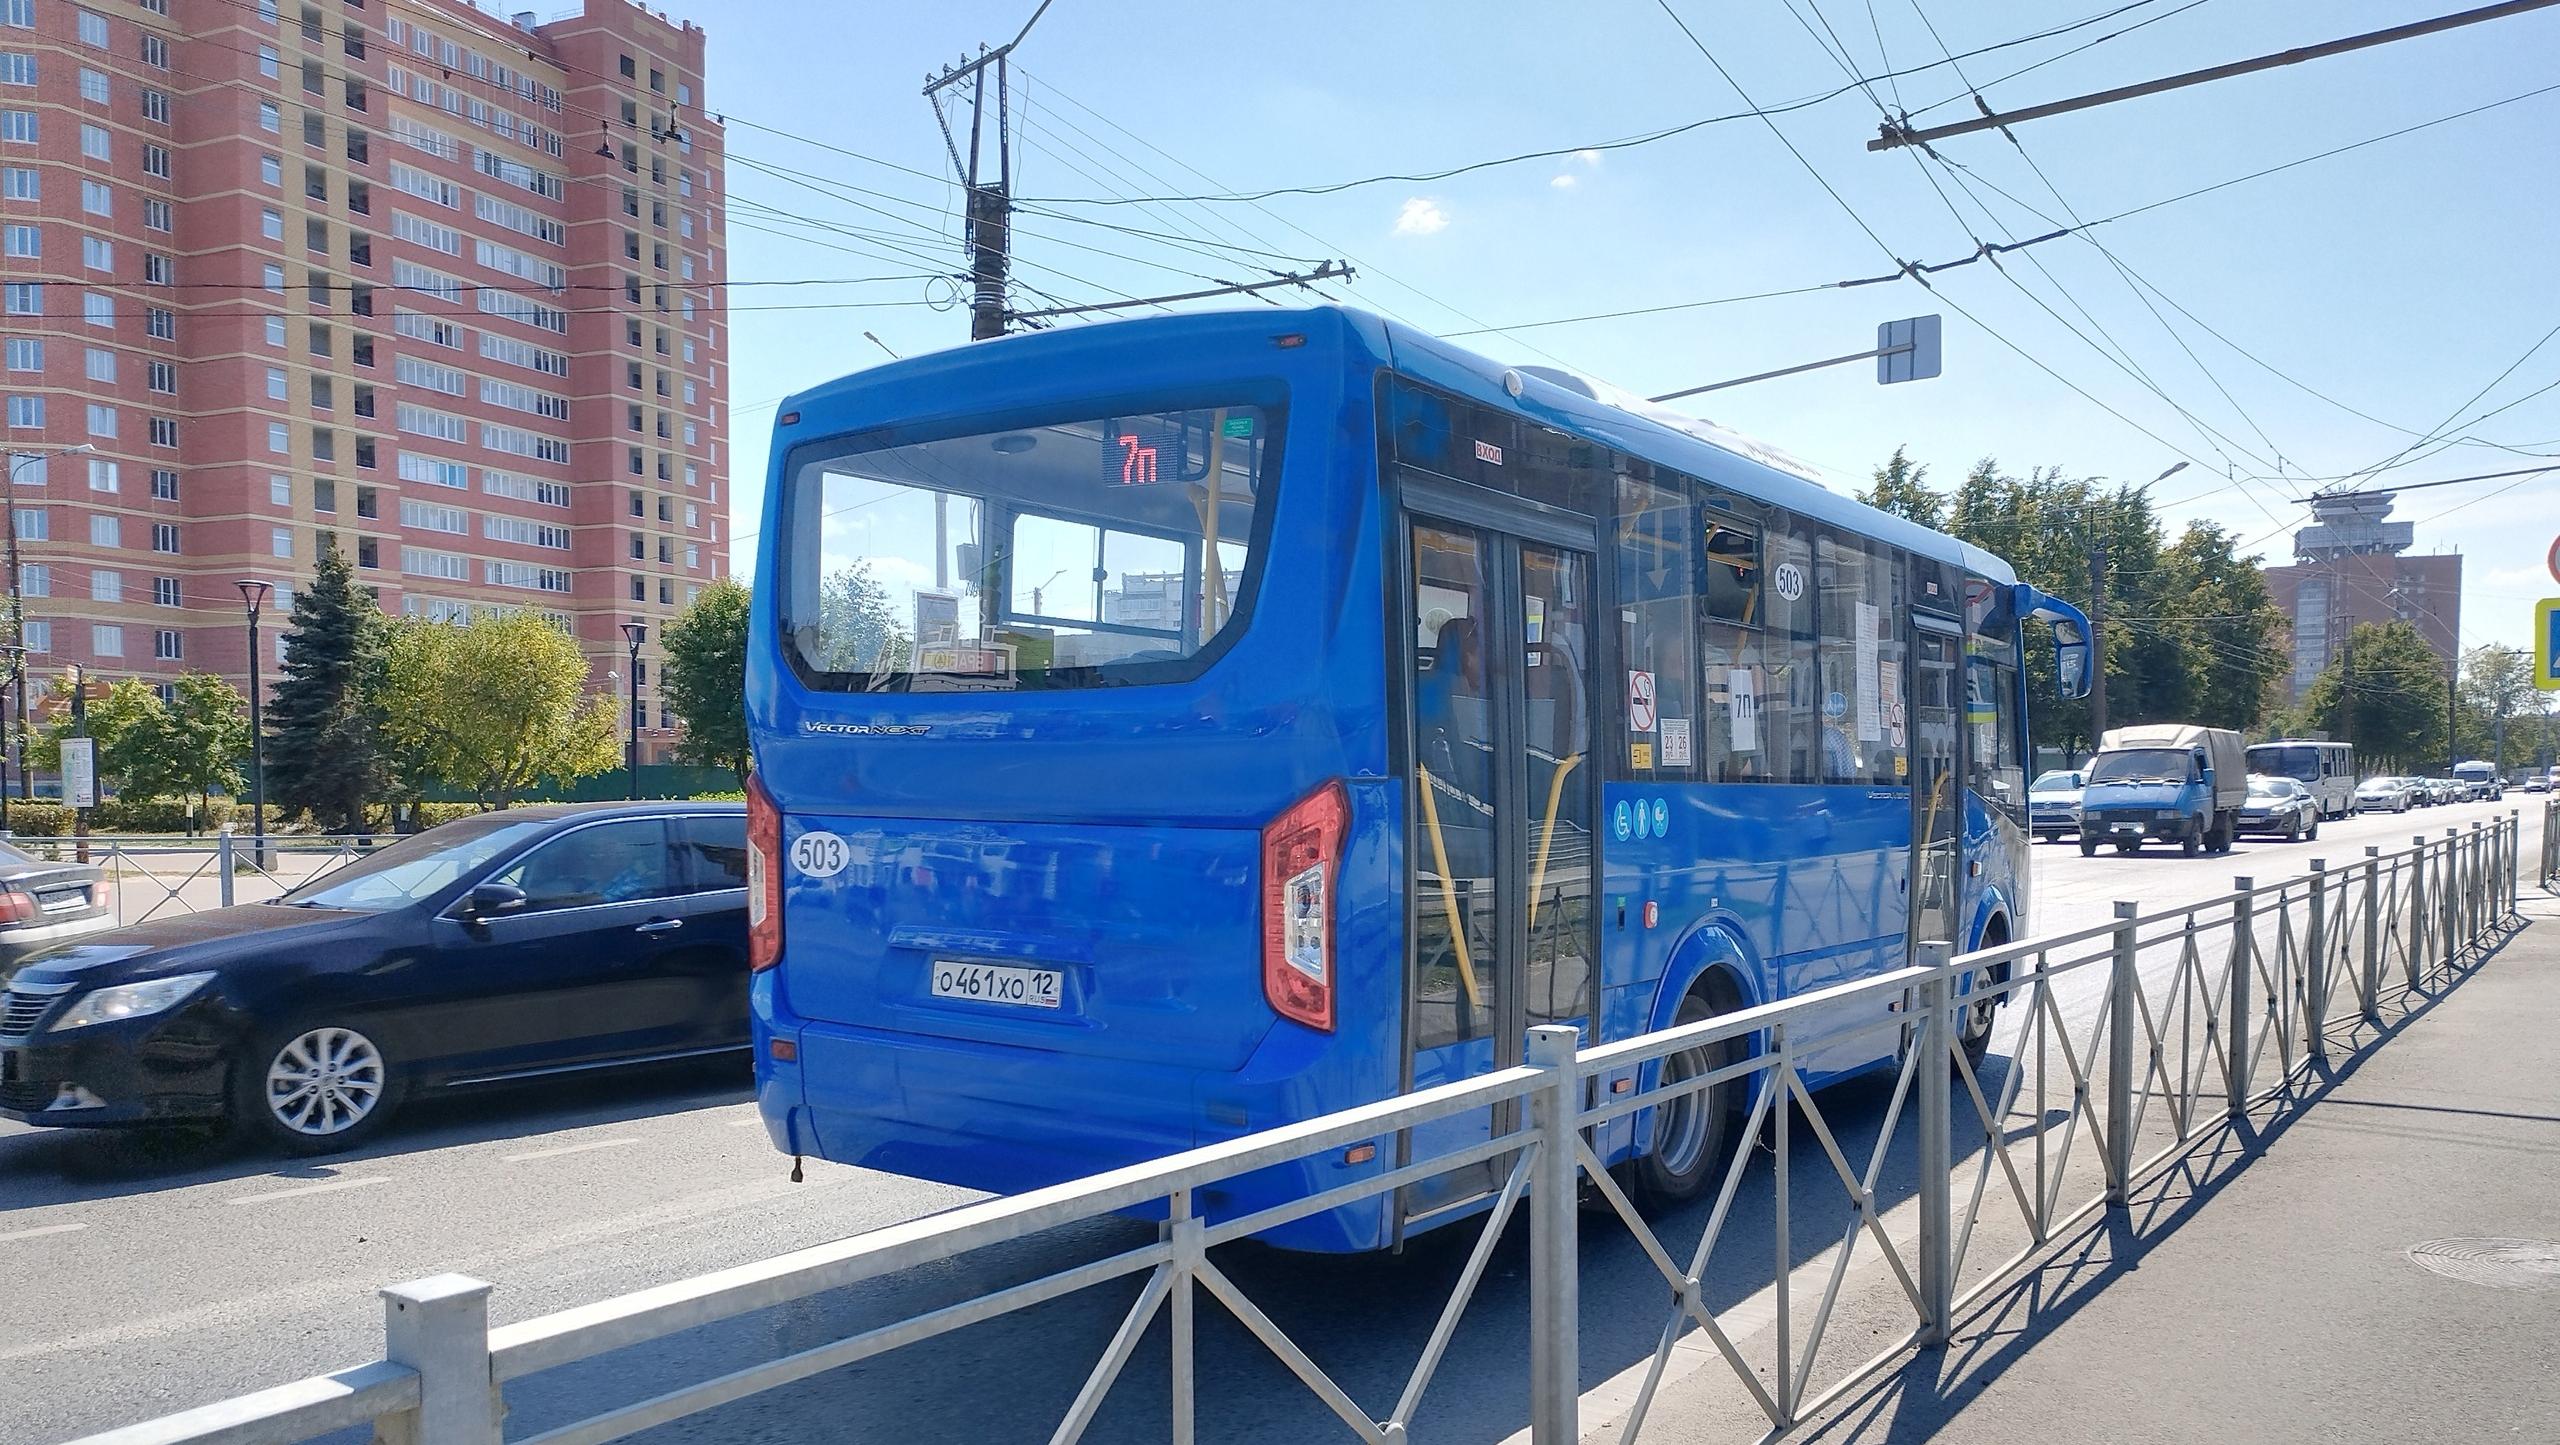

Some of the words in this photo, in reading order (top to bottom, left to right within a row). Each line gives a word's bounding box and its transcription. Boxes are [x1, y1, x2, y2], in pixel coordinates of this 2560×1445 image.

[1476, 442, 1501, 463] ВХОД
[1779, 567, 1799, 596] 503
[799, 839, 840, 870] 503
[1032, 973, 1053, 995] 12
[1029, 995, 1045, 1004] RUS
